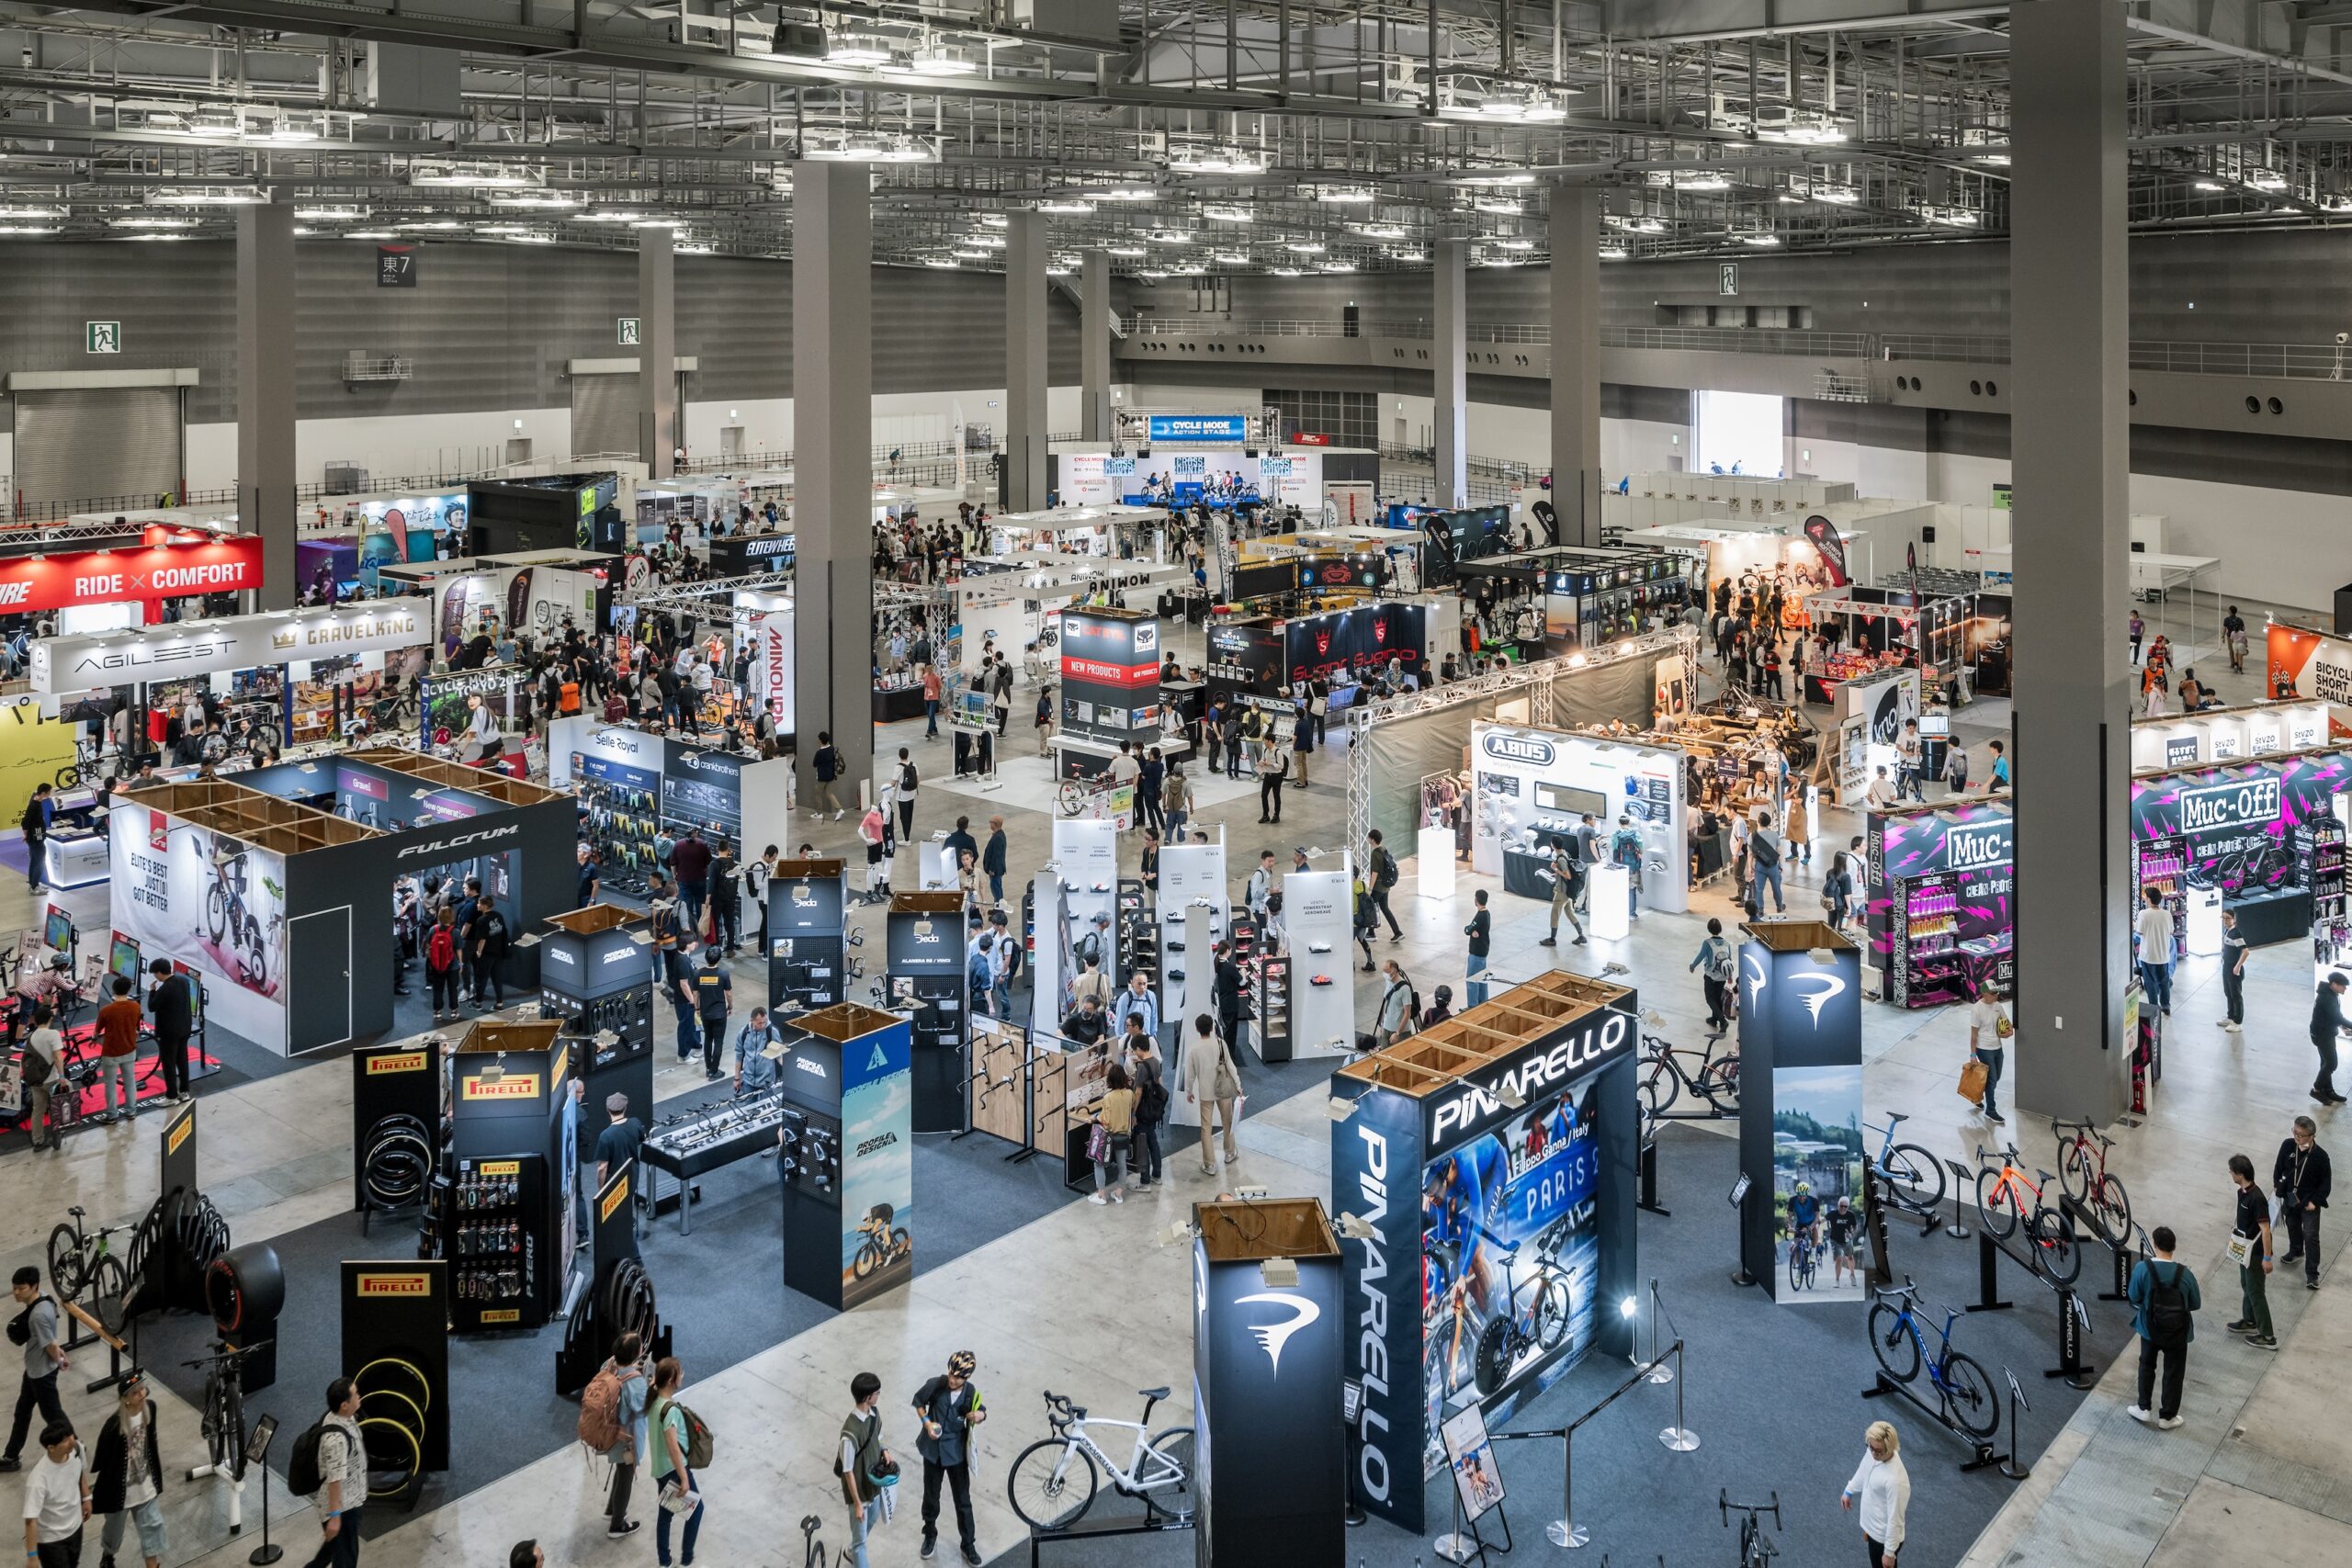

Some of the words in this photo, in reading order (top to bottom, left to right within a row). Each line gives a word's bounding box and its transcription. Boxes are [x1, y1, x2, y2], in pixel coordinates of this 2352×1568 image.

[1176, 457, 1204, 466] CROSS
[1262, 459, 1290, 468] CROSS
[746, 539, 794, 556] ELITEWHEE
[1430, 525, 1447, 551] ROCKBROS
[75, 574, 123, 597] RIDE
[153, 562, 246, 589] COMFORT
[1090, 573, 1149, 592] ANIWOW
[75, 640, 237, 672] AGILEST
[1353, 649, 1416, 668] Sugino
[769, 626, 784, 724] MINOURA
[1071, 661, 1085, 671] NEW
[1087, 663, 1121, 679] PRODUCTS
[1140, 668, 1158, 676] PRODUCTS
[430, 678, 466, 696] CYCLE
[469, 671, 501, 685] MODE
[457, 680, 496, 698] TOKYO
[499, 671, 526, 687] 2025
[2316, 675, 2348, 692] SHORT
[1873, 708, 1897, 745] kno
[595, 733, 615, 749] Selle
[616, 738, 639, 754] Royal
[1493, 739, 1546, 761] ABUS
[700, 761, 739, 776] crankbrothers
[353, 779, 371, 793] Gravel
[424, 799, 435, 809] New
[2186, 784, 2277, 827] Muc-Off
[397, 825, 518, 858] FULCRUM
[1953, 833, 2012, 865] Muc-
[131, 852, 152, 870] ELITE'S
[153, 863, 168, 879] BEST
[133, 886, 145, 904] GOT
[146, 891, 168, 912] BETTER
[914, 933, 939, 943] Deda
[372, 1055, 422, 1070] PIRELLI
[797, 1056, 820, 1068] PROFILE
[797, 1062, 820, 1075] DESIGN
[469, 1078, 532, 1095] PIRELLI
[1431, 1013, 1625, 1145] PINARELLO
[93, 1106, 126, 1121] RIE
[170, 1117, 191, 1152] PIRELLI
[691, 1123, 755, 1149] ROFILE
[856, 1133, 889, 1151] PROFILE
[856, 1141, 888, 1157] DESIGN
[1514, 1151, 1541, 1173] Filippo
[1542, 1136, 1566, 1156] Ganna
[1573, 1122, 1589, 1139] Italy
[483, 1164, 515, 1173] PIRELLI
[604, 1179, 627, 1214] PIRELLI
[1486, 1185, 1502, 1226] ITALIA
[526, 1235, 534, 1283] ZERO
[364, 1278, 424, 1292] PIRELLI
[525, 1285, 533, 1298] P
[483, 1311, 515, 1322] PIRELLI
[1358, 1124, 1391, 1505] PINARELLO
[2065, 1298, 2074, 1359] PINARELLO
[1080, 1437, 1115, 1474] PINARELLO
